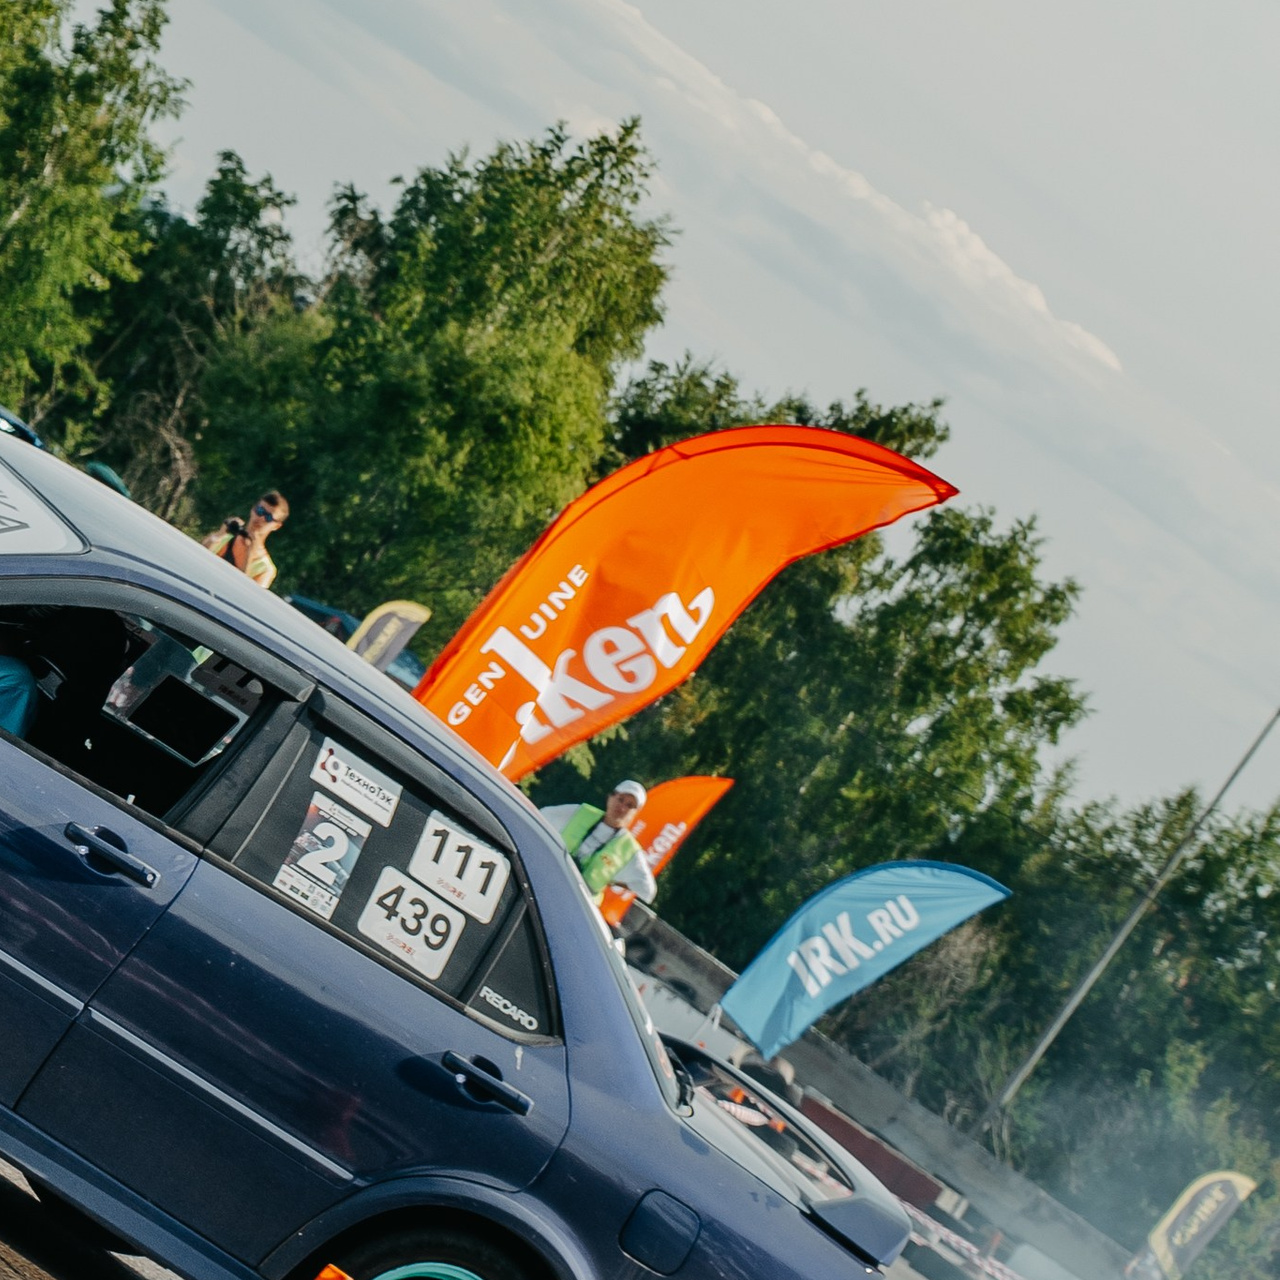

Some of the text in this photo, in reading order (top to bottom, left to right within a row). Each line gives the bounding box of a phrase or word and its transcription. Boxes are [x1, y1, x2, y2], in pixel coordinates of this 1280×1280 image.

[297, 821, 349, 887] 2
[432, 828, 497, 897] 111
[375, 884, 452, 951] 439
[786, 894, 920, 1000] IRK.RU
[479, 985, 539, 1031] RECARO
